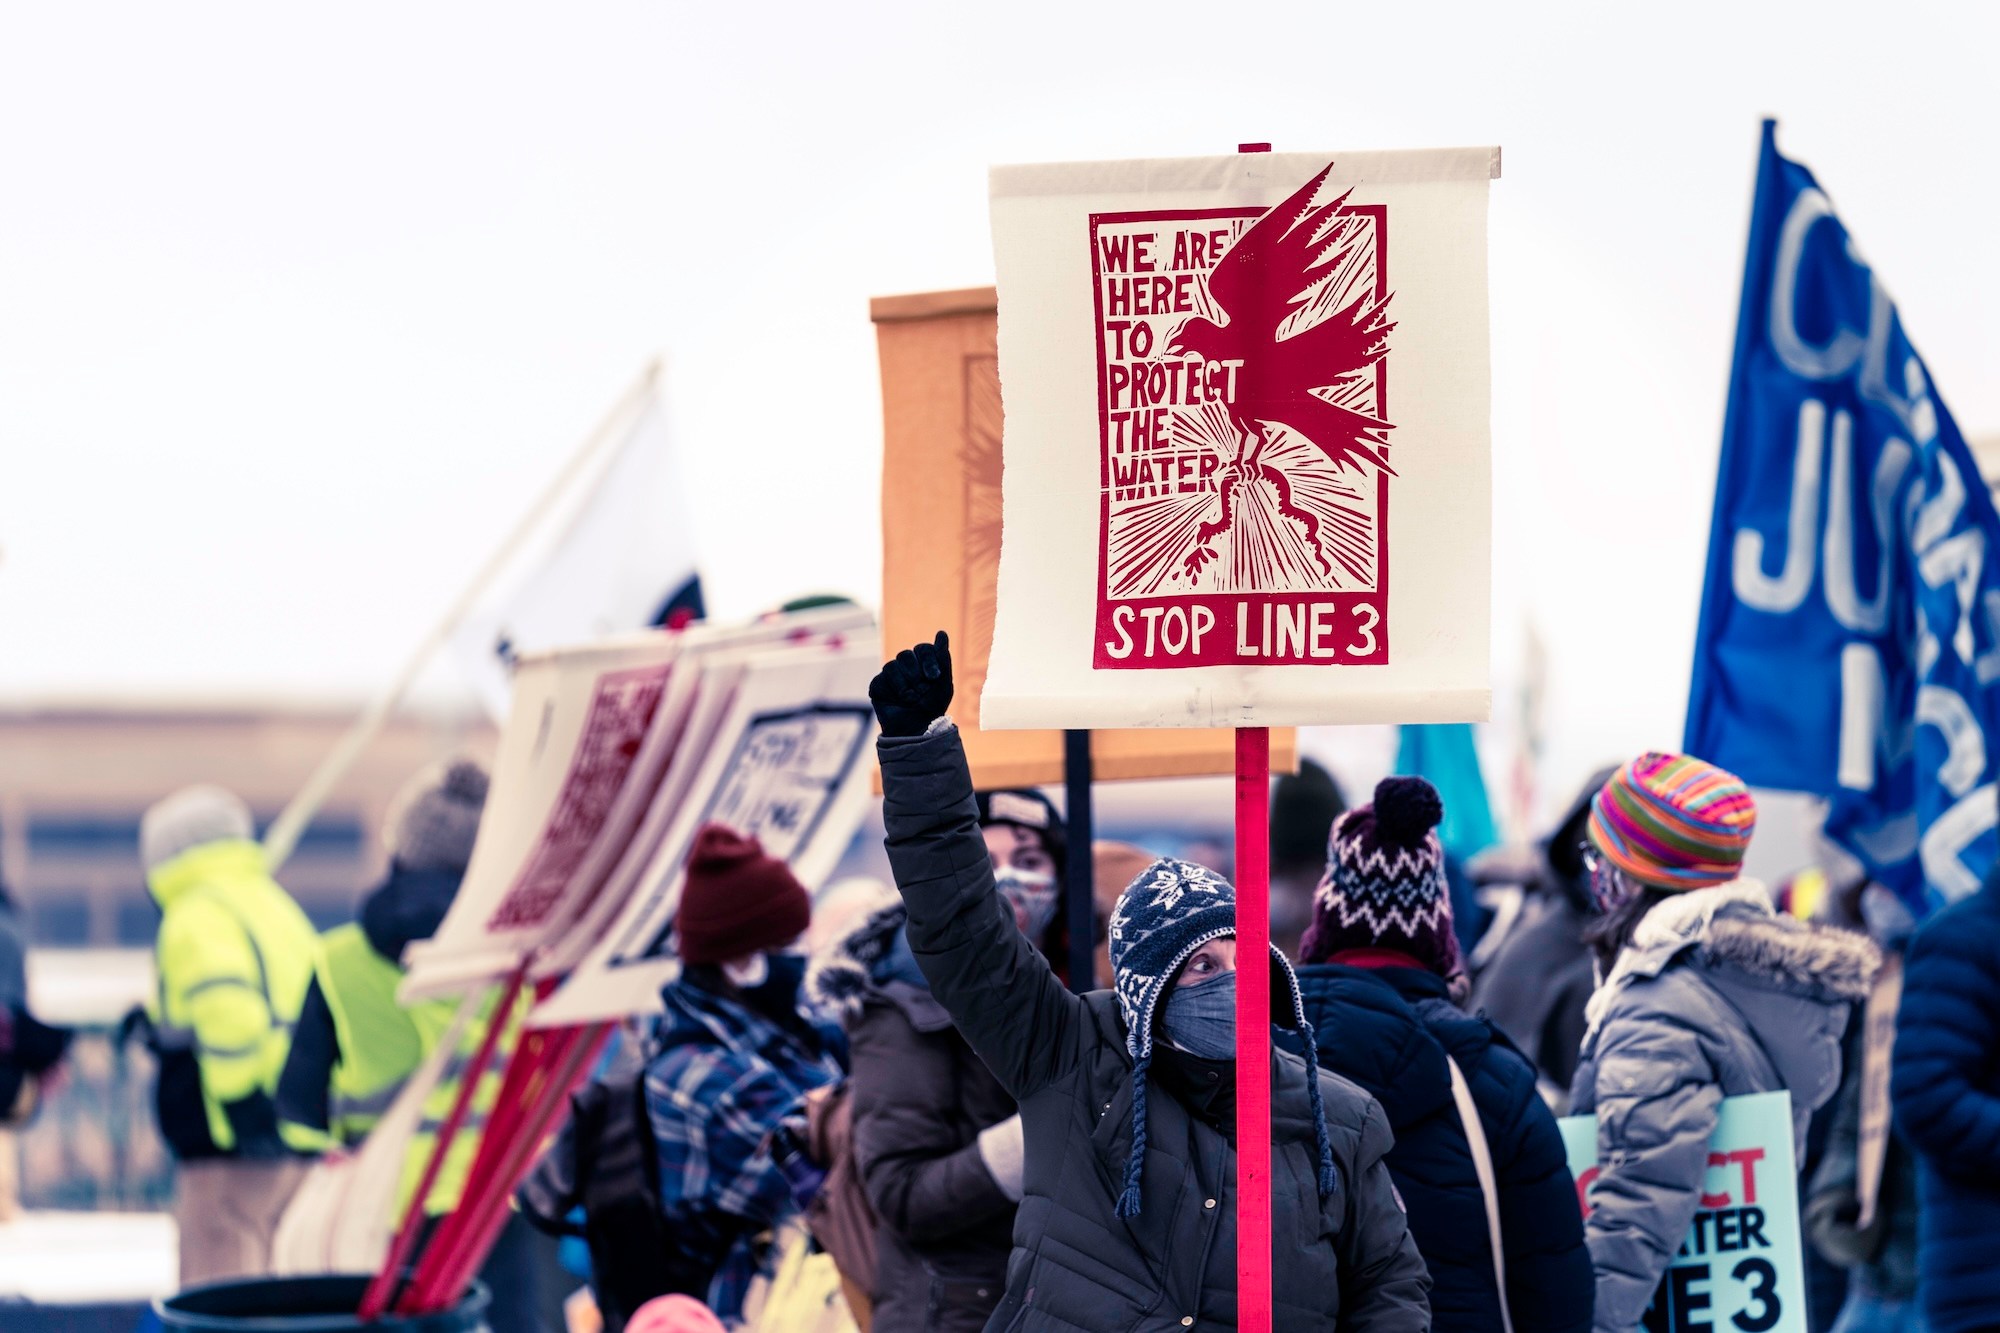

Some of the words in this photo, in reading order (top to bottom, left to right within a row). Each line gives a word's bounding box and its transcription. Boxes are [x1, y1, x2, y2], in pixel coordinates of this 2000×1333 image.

[1101, 233, 1154, 272] WE
[1172, 230, 1228, 270] ARE
[1108, 274, 1193, 316] HERE
[1107, 320, 1153, 360] TO
[1109, 359, 1244, 409] PROTECT
[1111, 408, 1169, 453] THE
[1112, 454, 1219, 500] WATER
[1105, 604, 1215, 658] STOP
[1236, 602, 1335, 658] LINE
[1346, 602, 1380, 656] 3
[1730, 1257, 1782, 1333] 3
